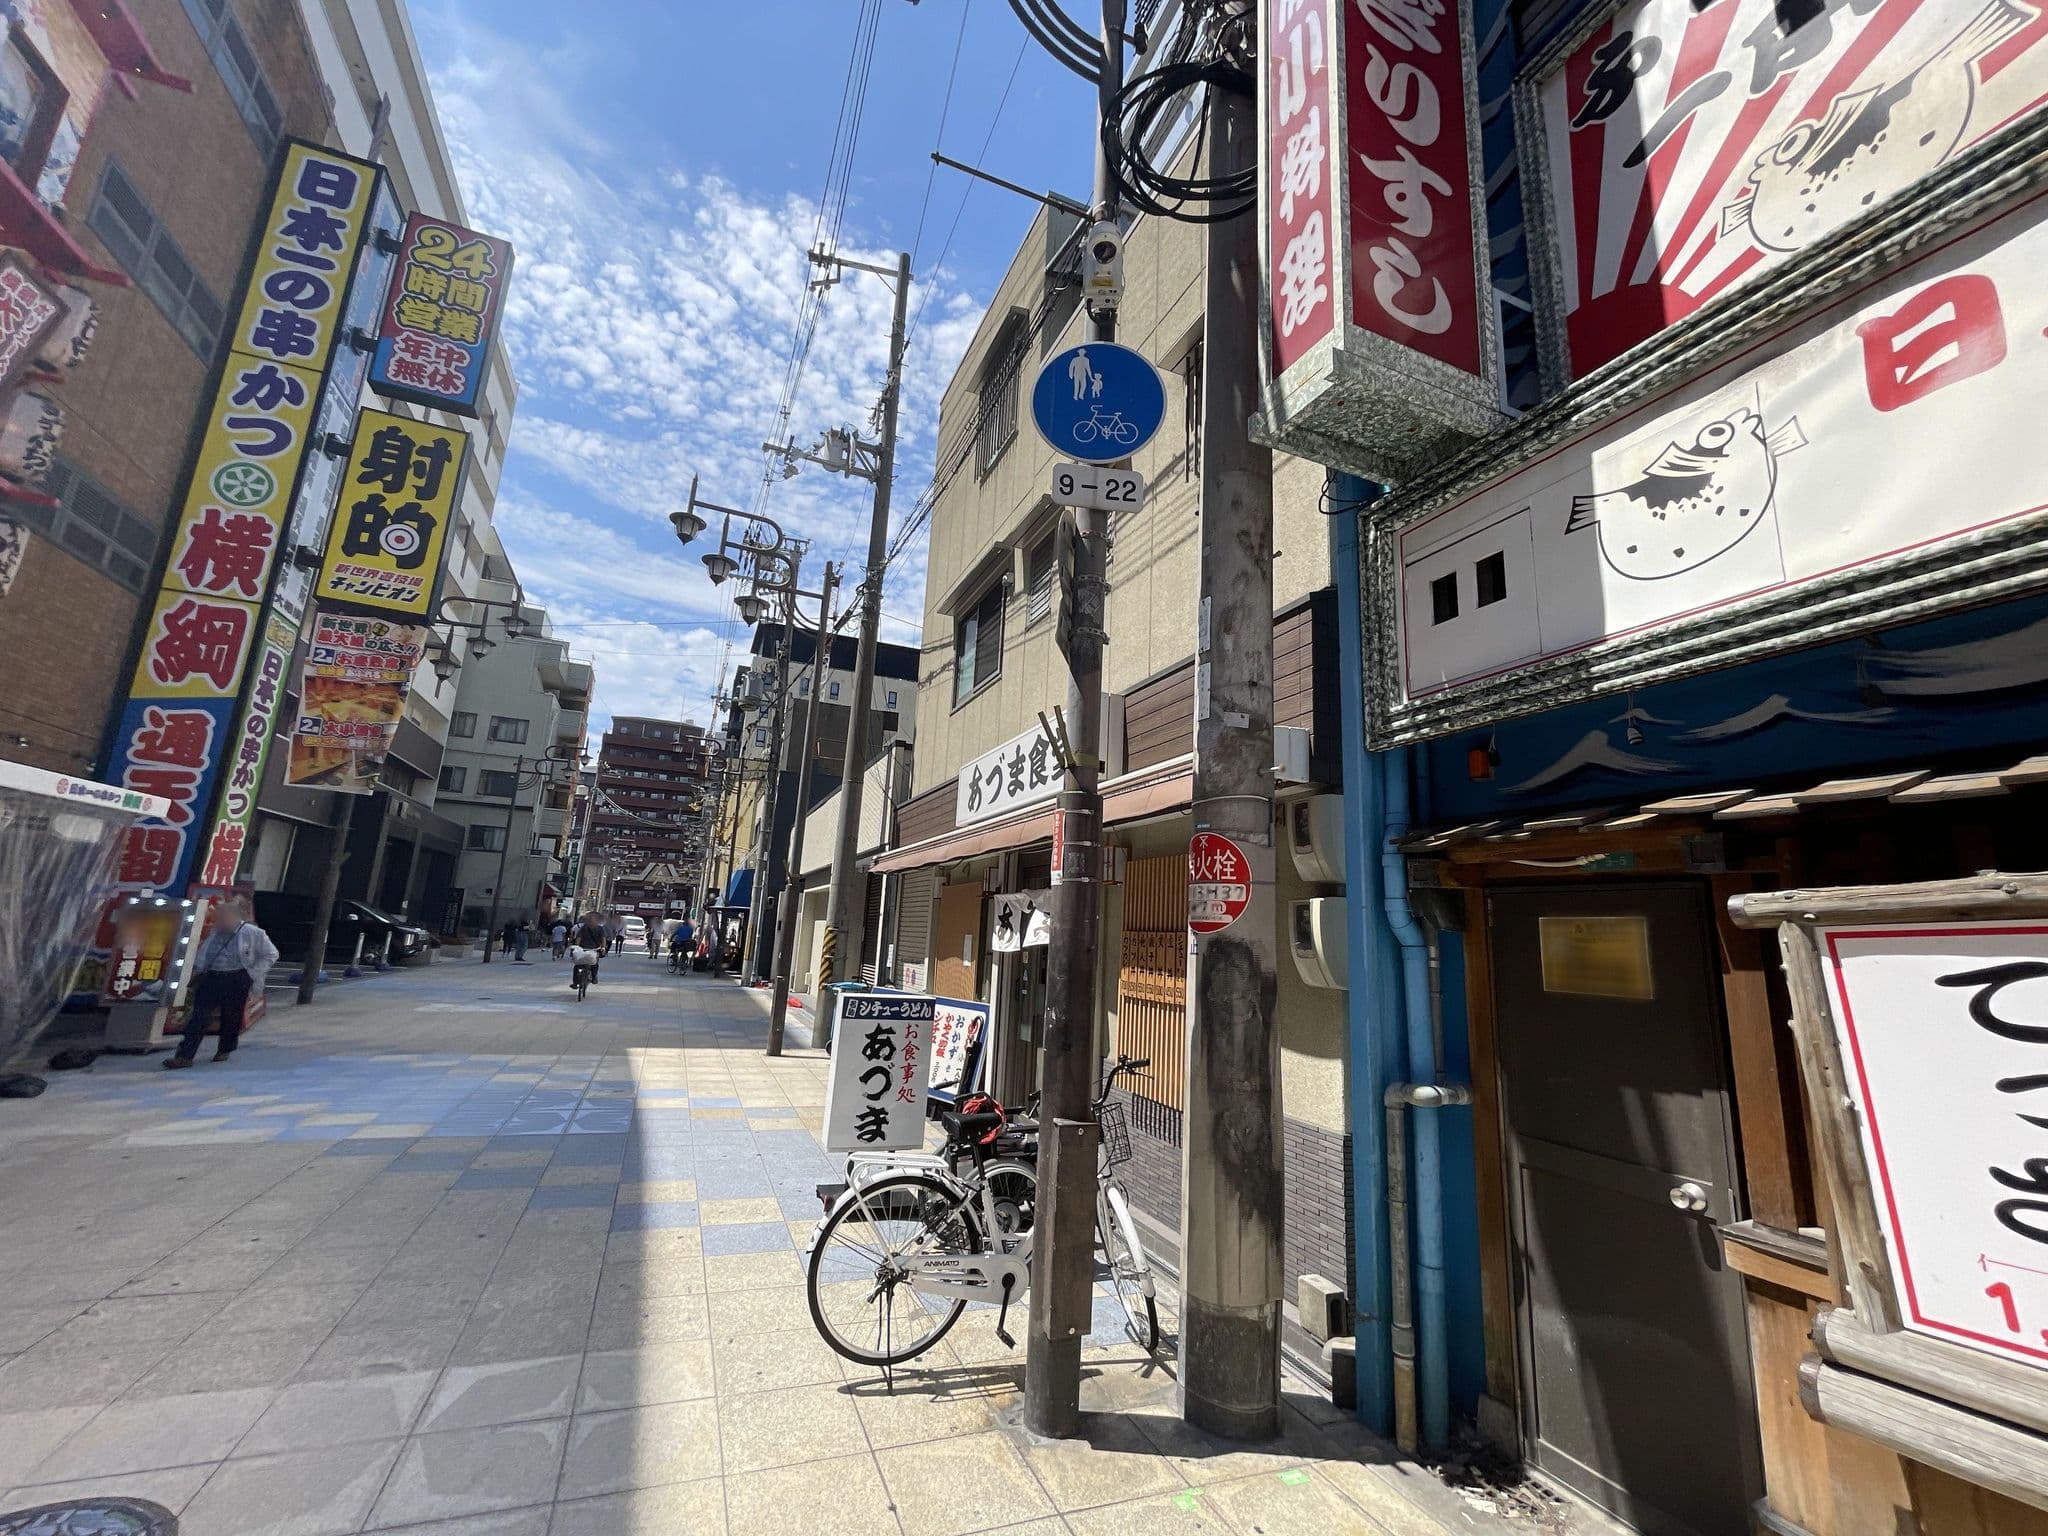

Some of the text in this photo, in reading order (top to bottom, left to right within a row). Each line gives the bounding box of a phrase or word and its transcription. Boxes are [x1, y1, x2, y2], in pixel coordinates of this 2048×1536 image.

[412, 226, 496, 280] 24
[226, 158, 361, 460] 日本一の串かつ
[403, 262, 490, 313] 時間
[396, 296, 482, 343] 営業
[390, 357, 463, 393] 無休
[396, 333, 468, 368] 年中
[342, 425, 453, 570] 射的
[149, 507, 278, 692] 横綱
[329, 576, 421, 604] チャンピオン
[333, 562, 425, 588] 新世界遊技場
[228, 650, 283, 814] 日本一の串かつ
[95, 708, 212, 948] 通天閣
[859, 1000, 932, 1018] シチューうどん
[854, 1023, 897, 1143] あづま
[896, 1023, 920, 1103] お食事処
